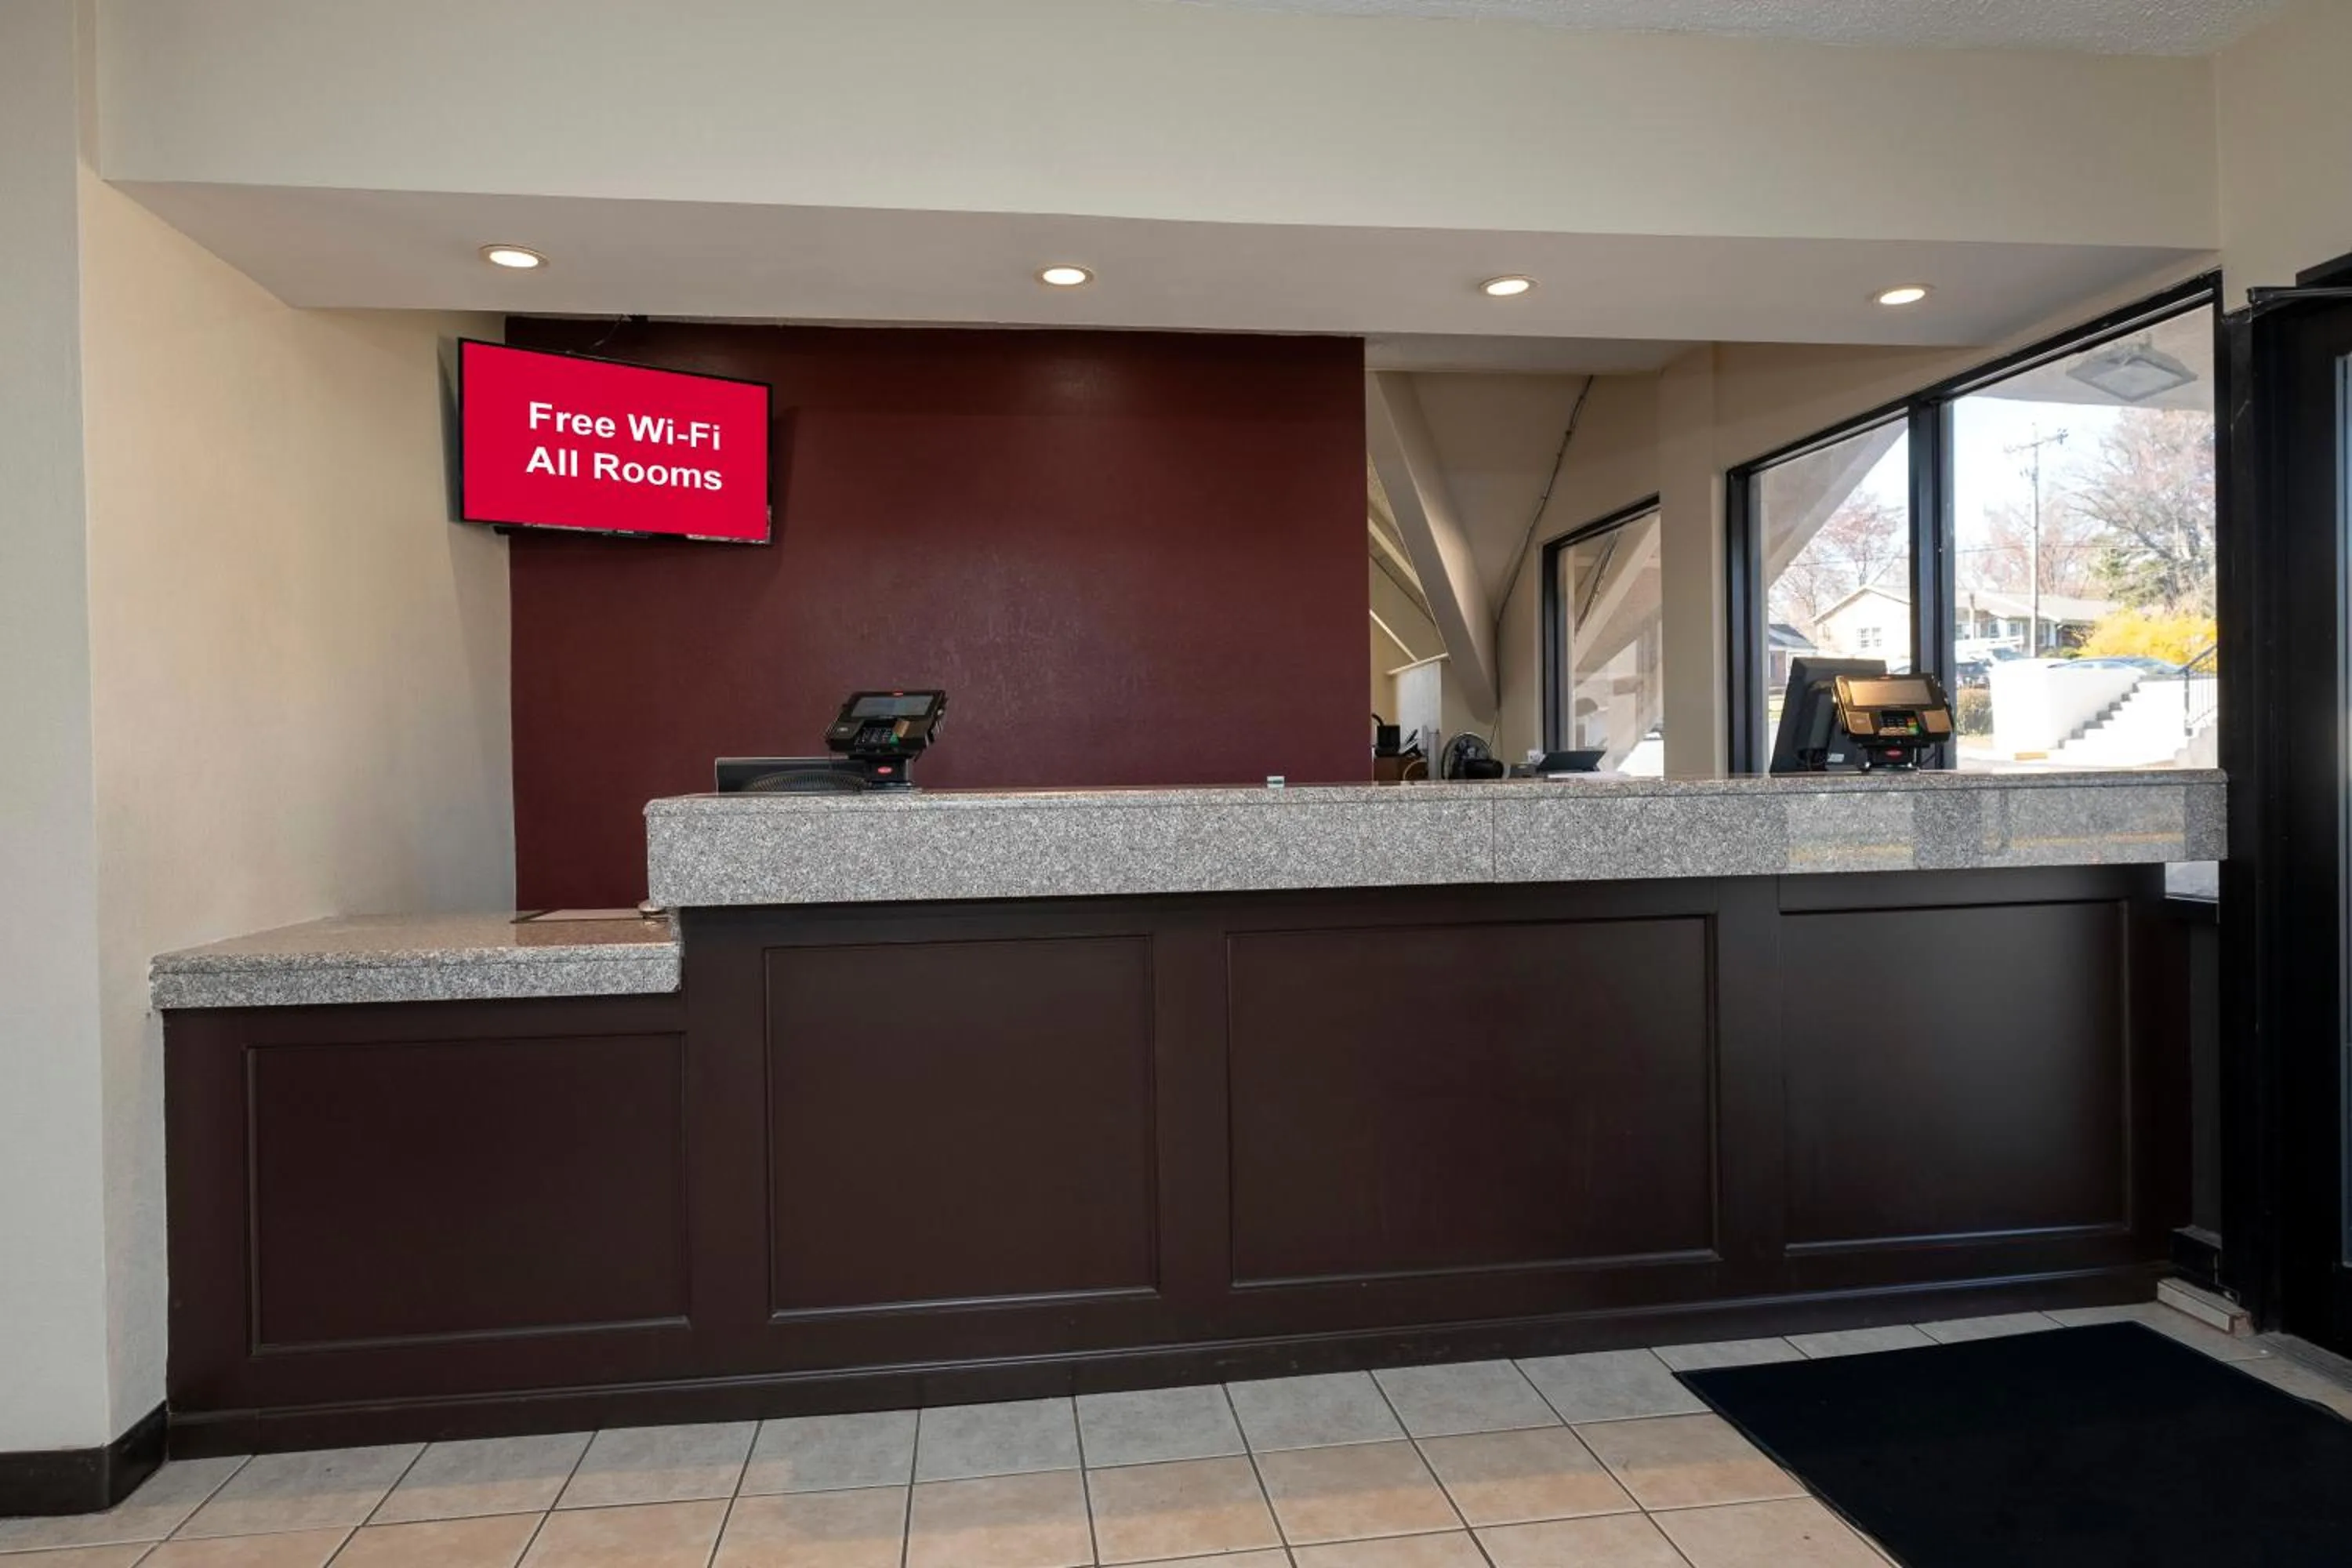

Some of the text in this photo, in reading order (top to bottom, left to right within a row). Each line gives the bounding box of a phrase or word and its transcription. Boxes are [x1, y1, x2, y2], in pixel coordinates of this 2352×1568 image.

[528, 401, 721, 450] Free Wi-Fi
[525, 446, 723, 490] All Rooms
